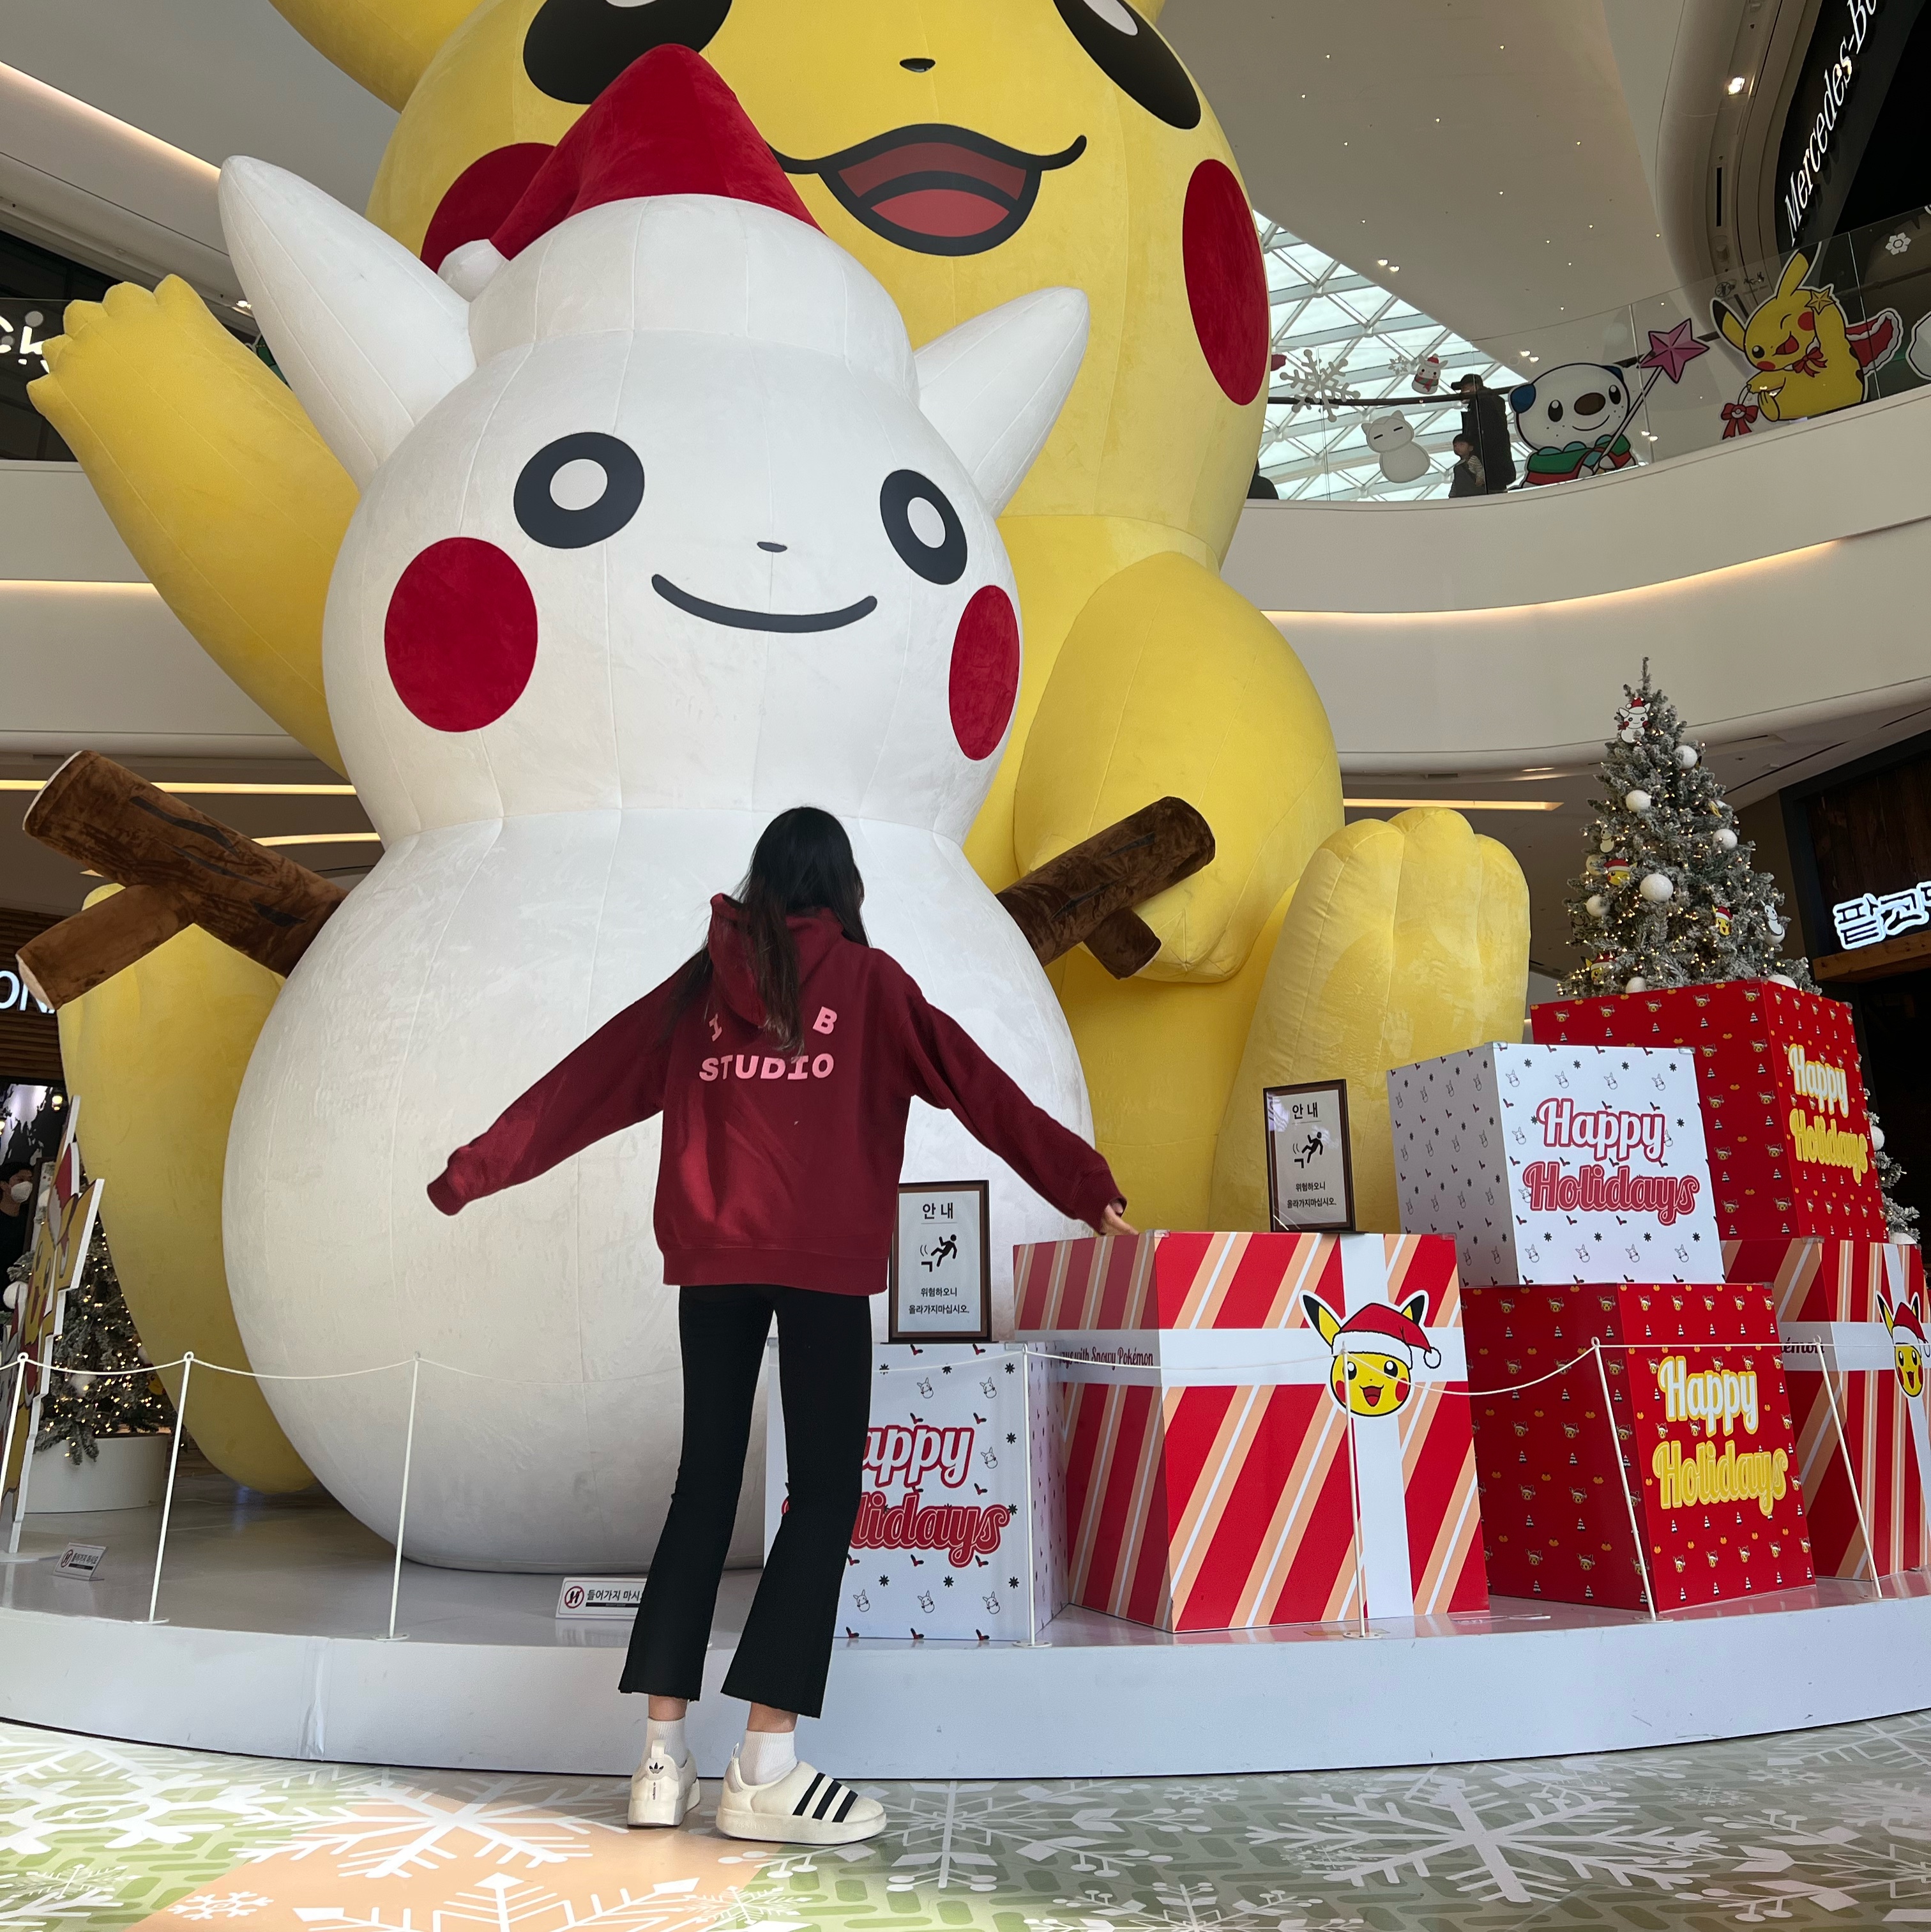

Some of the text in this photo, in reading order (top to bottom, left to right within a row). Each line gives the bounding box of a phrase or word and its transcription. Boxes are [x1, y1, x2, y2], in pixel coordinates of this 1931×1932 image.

[699, 1053, 834, 1081] STUDIO
[1789, 1043, 1849, 1118] Happy
[1536, 1098, 1665, 1162] Happy
[1789, 1108, 1868, 1183] Holidays
[1296, 1181, 1326, 1192] 위험하오니
[1522, 1161, 1700, 1226] Holidays
[920, 1287, 957, 1297] 위험하오니
[1091, 1346, 1116, 1371] Snowy
[1117, 1347, 1154, 1366] Pokémon
[1657, 1355, 1759, 1438] Happy
[862, 1425, 974, 1487] appy
[1652, 1440, 1789, 1516] Holidays
[850, 1491, 1010, 1567] lidays
[587, 1590, 642, 1601] 들어가지 마시
